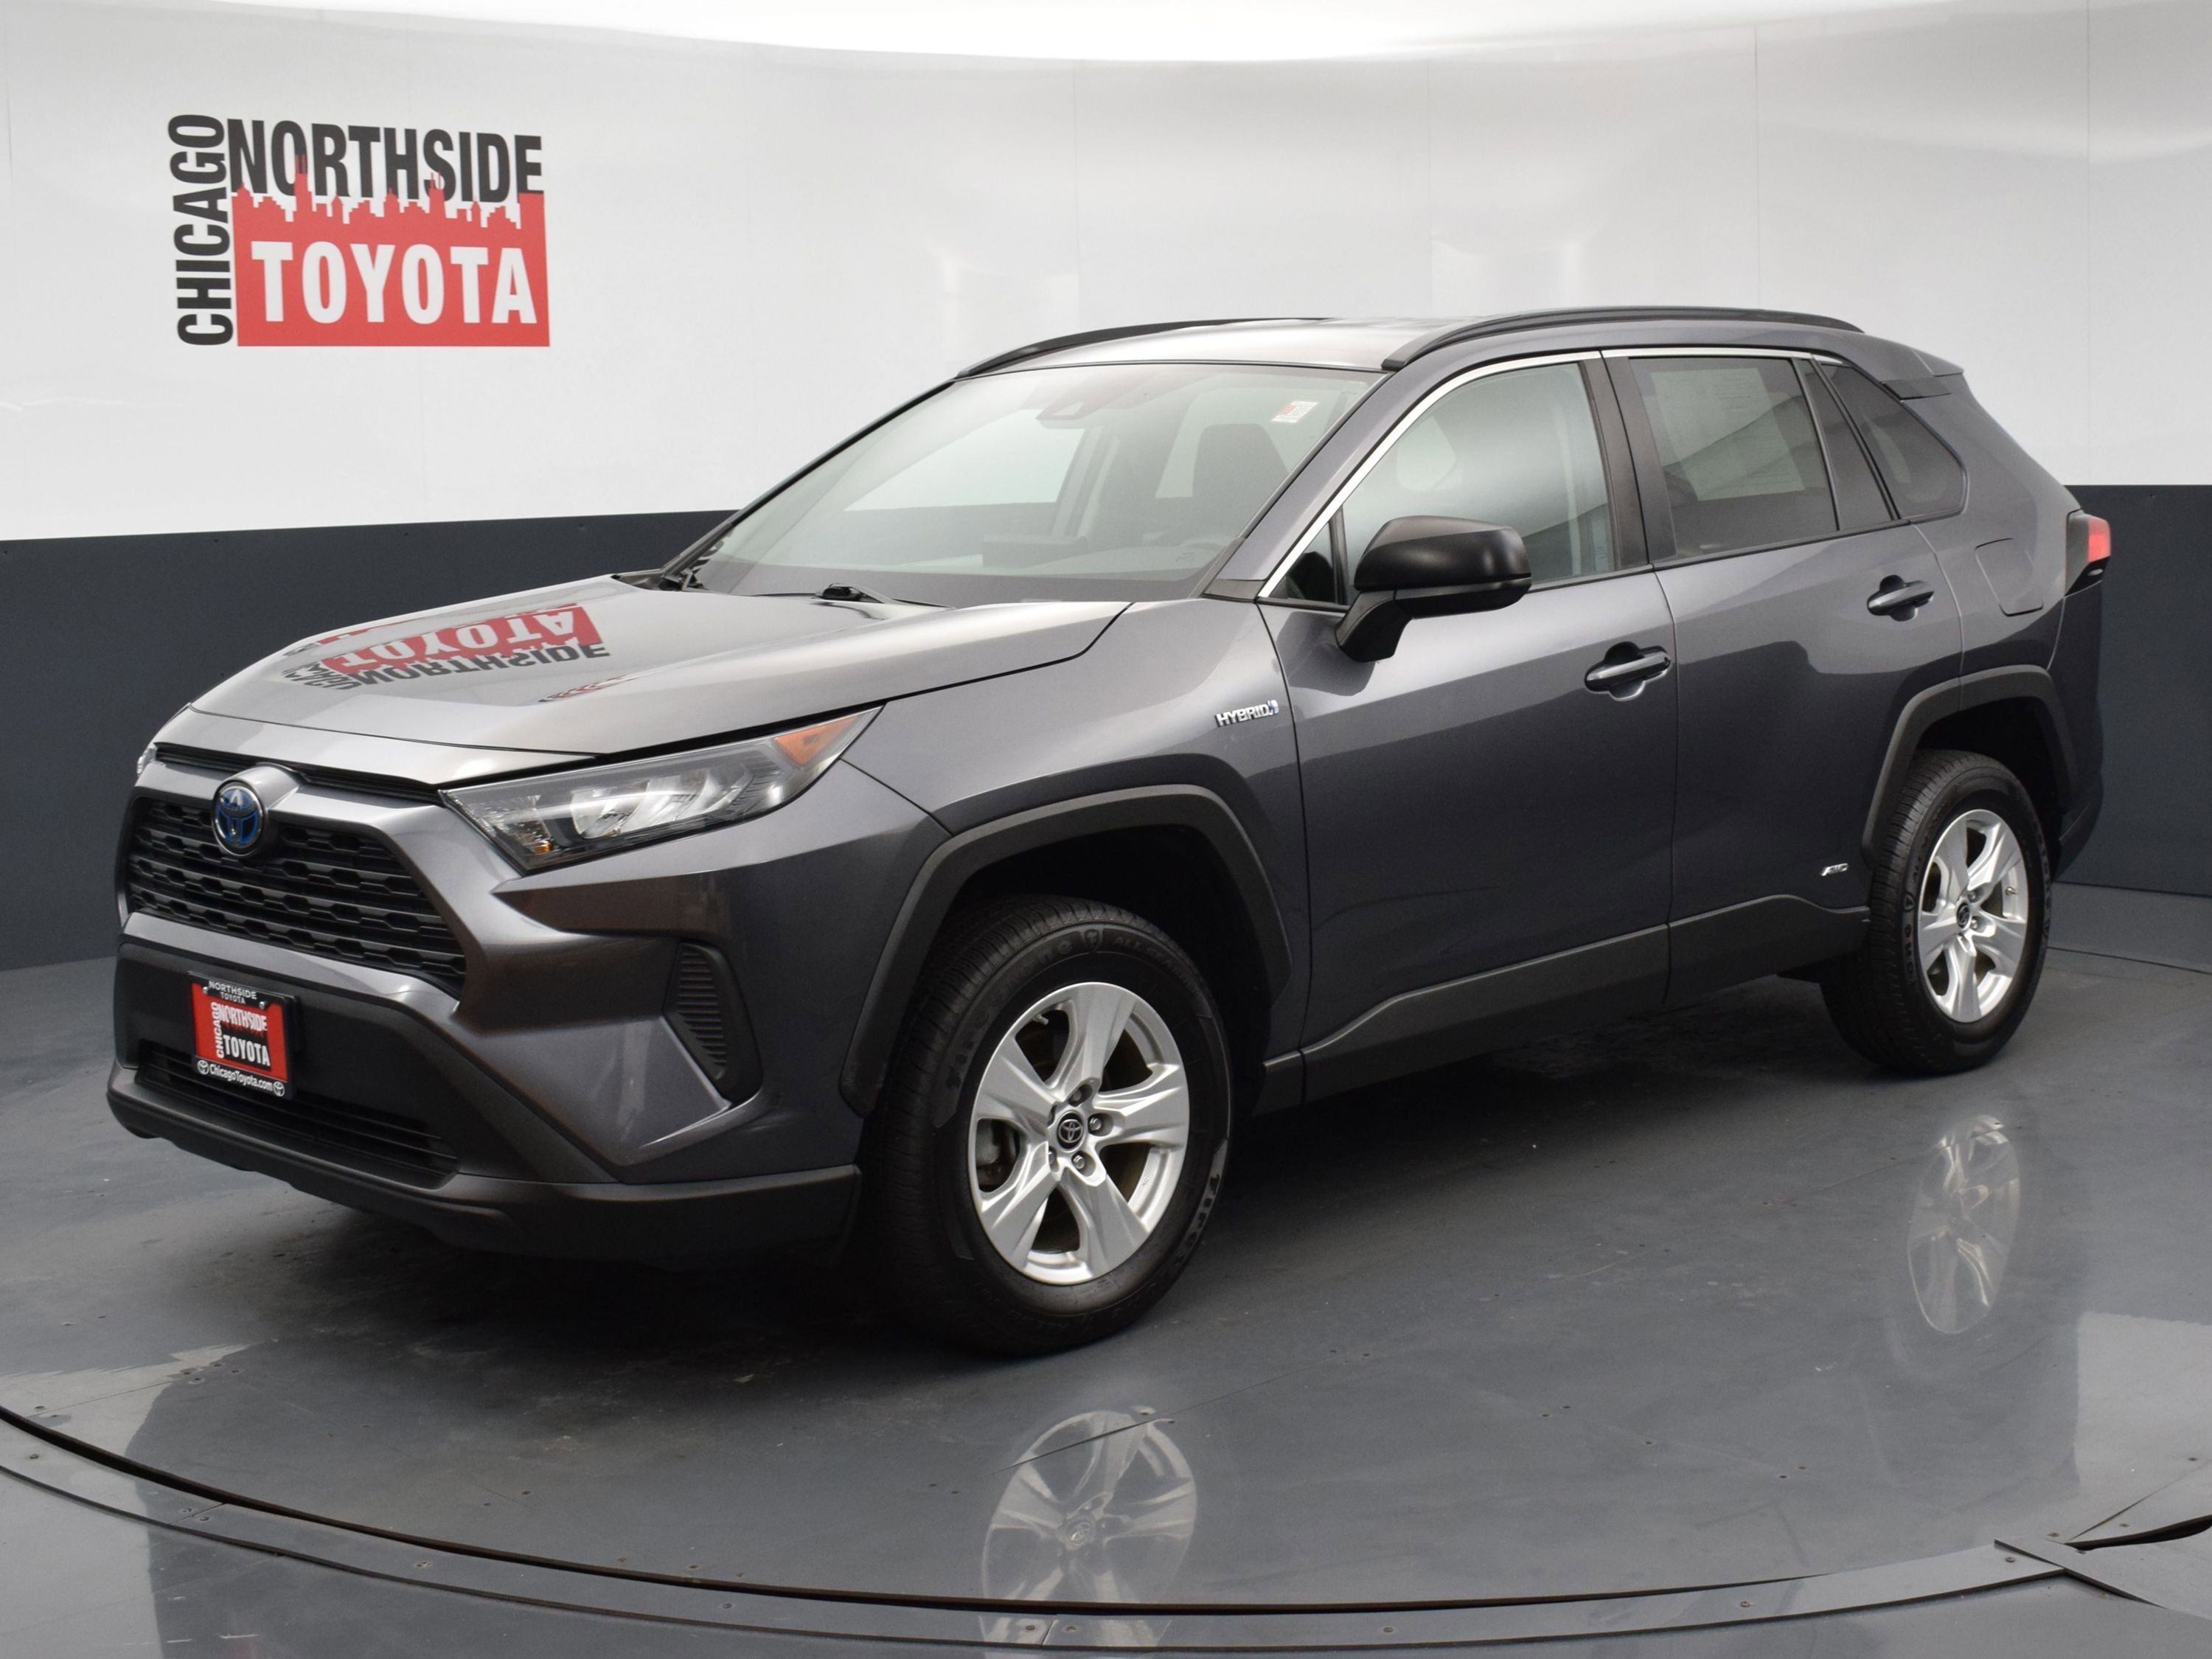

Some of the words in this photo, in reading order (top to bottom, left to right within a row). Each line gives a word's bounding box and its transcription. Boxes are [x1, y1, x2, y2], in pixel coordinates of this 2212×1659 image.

[226, 118, 544, 203] NORTHSIDE
[167, 114, 234, 345] CHICAGO
[251, 240, 538, 324] TOYOTA
[1214, 703, 1270, 727] HYBRID
[208, 981, 258, 1000] NORTHSIDE
[220, 992, 246, 1005] TOYOTA
[211, 1002, 225, 1059] CHICAGO
[219, 1005, 268, 1032] NORTHSIDE
[223, 1034, 271, 1067] TOYOTA
[209, 1063, 274, 1091] ChicagoToyota.com
